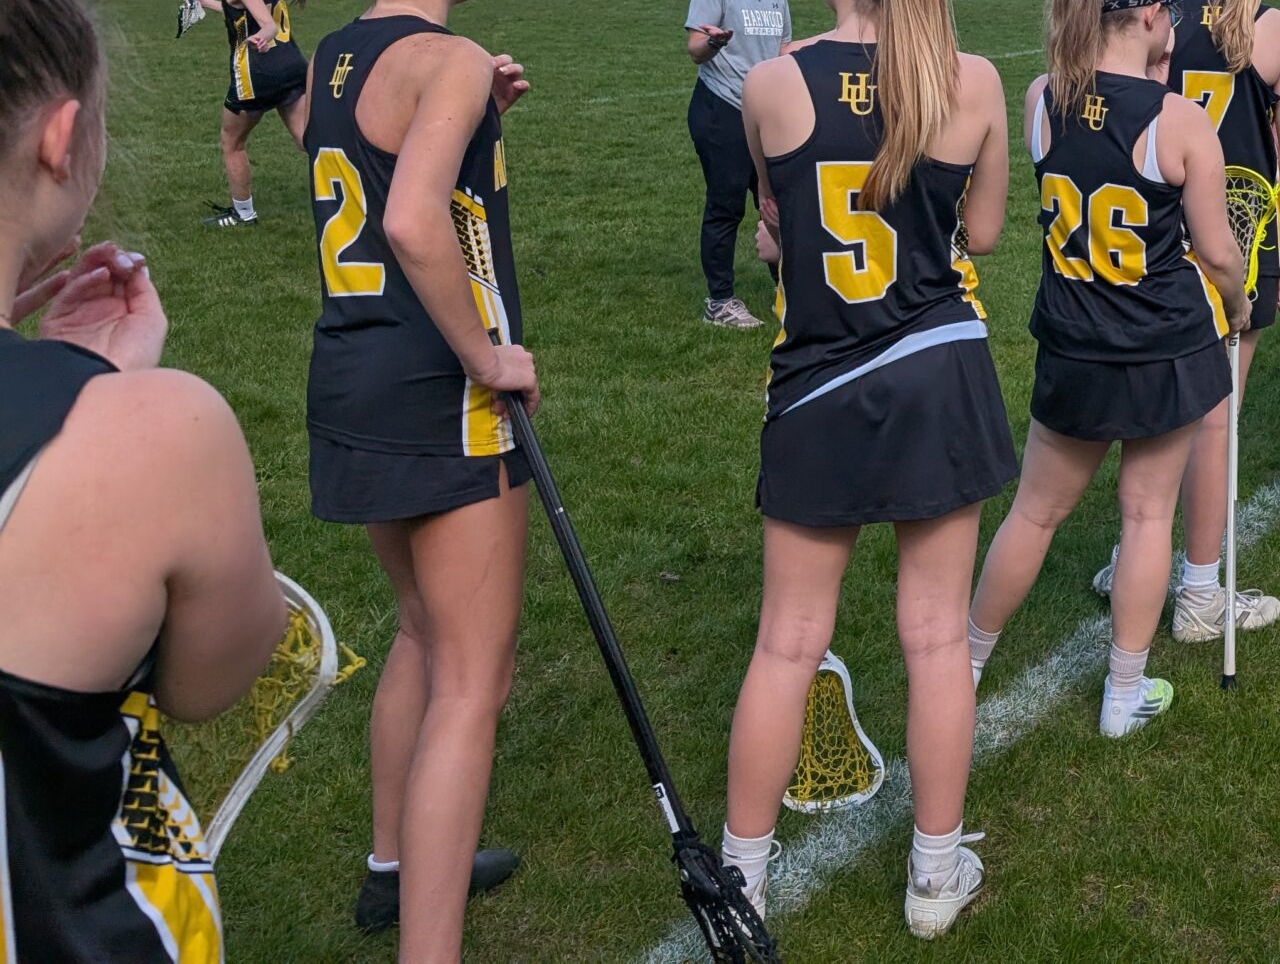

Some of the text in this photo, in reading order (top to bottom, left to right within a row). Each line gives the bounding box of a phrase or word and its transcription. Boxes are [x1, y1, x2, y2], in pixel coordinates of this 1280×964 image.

[1182, 70, 1236, 134] 7
[314, 147, 386, 298] 2
[816, 161, 898, 305] 5
[1041, 172, 1149, 286] 26
